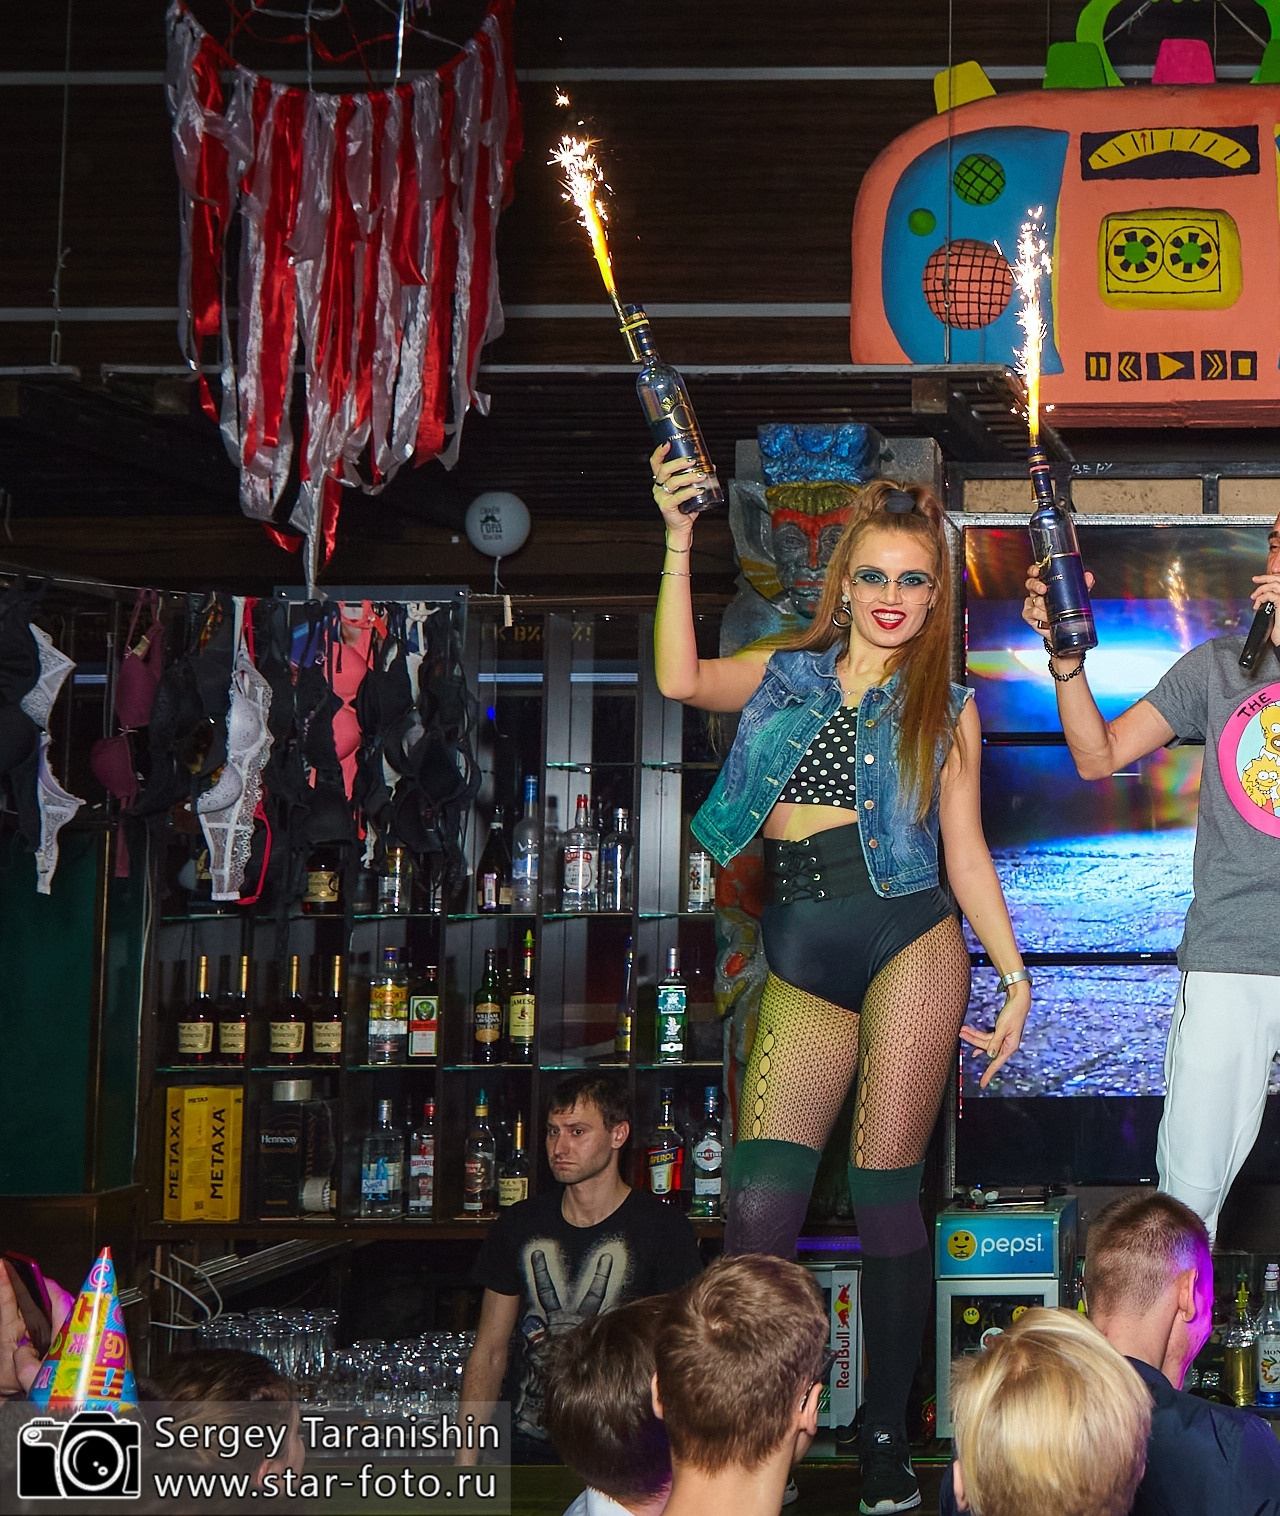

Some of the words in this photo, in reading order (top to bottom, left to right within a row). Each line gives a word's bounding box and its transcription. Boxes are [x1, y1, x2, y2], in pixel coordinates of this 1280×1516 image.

[1237, 692, 1272, 719] THE
[261, 1134, 297, 1145] Hennessy
[168, 1108, 181, 1199] METAXA
[210, 1108, 226, 1199] METAXA
[981, 1233, 1042, 1257] pepsi
[835, 1331, 850, 1358] Bull
[835, 1360, 850, 1389] Red
